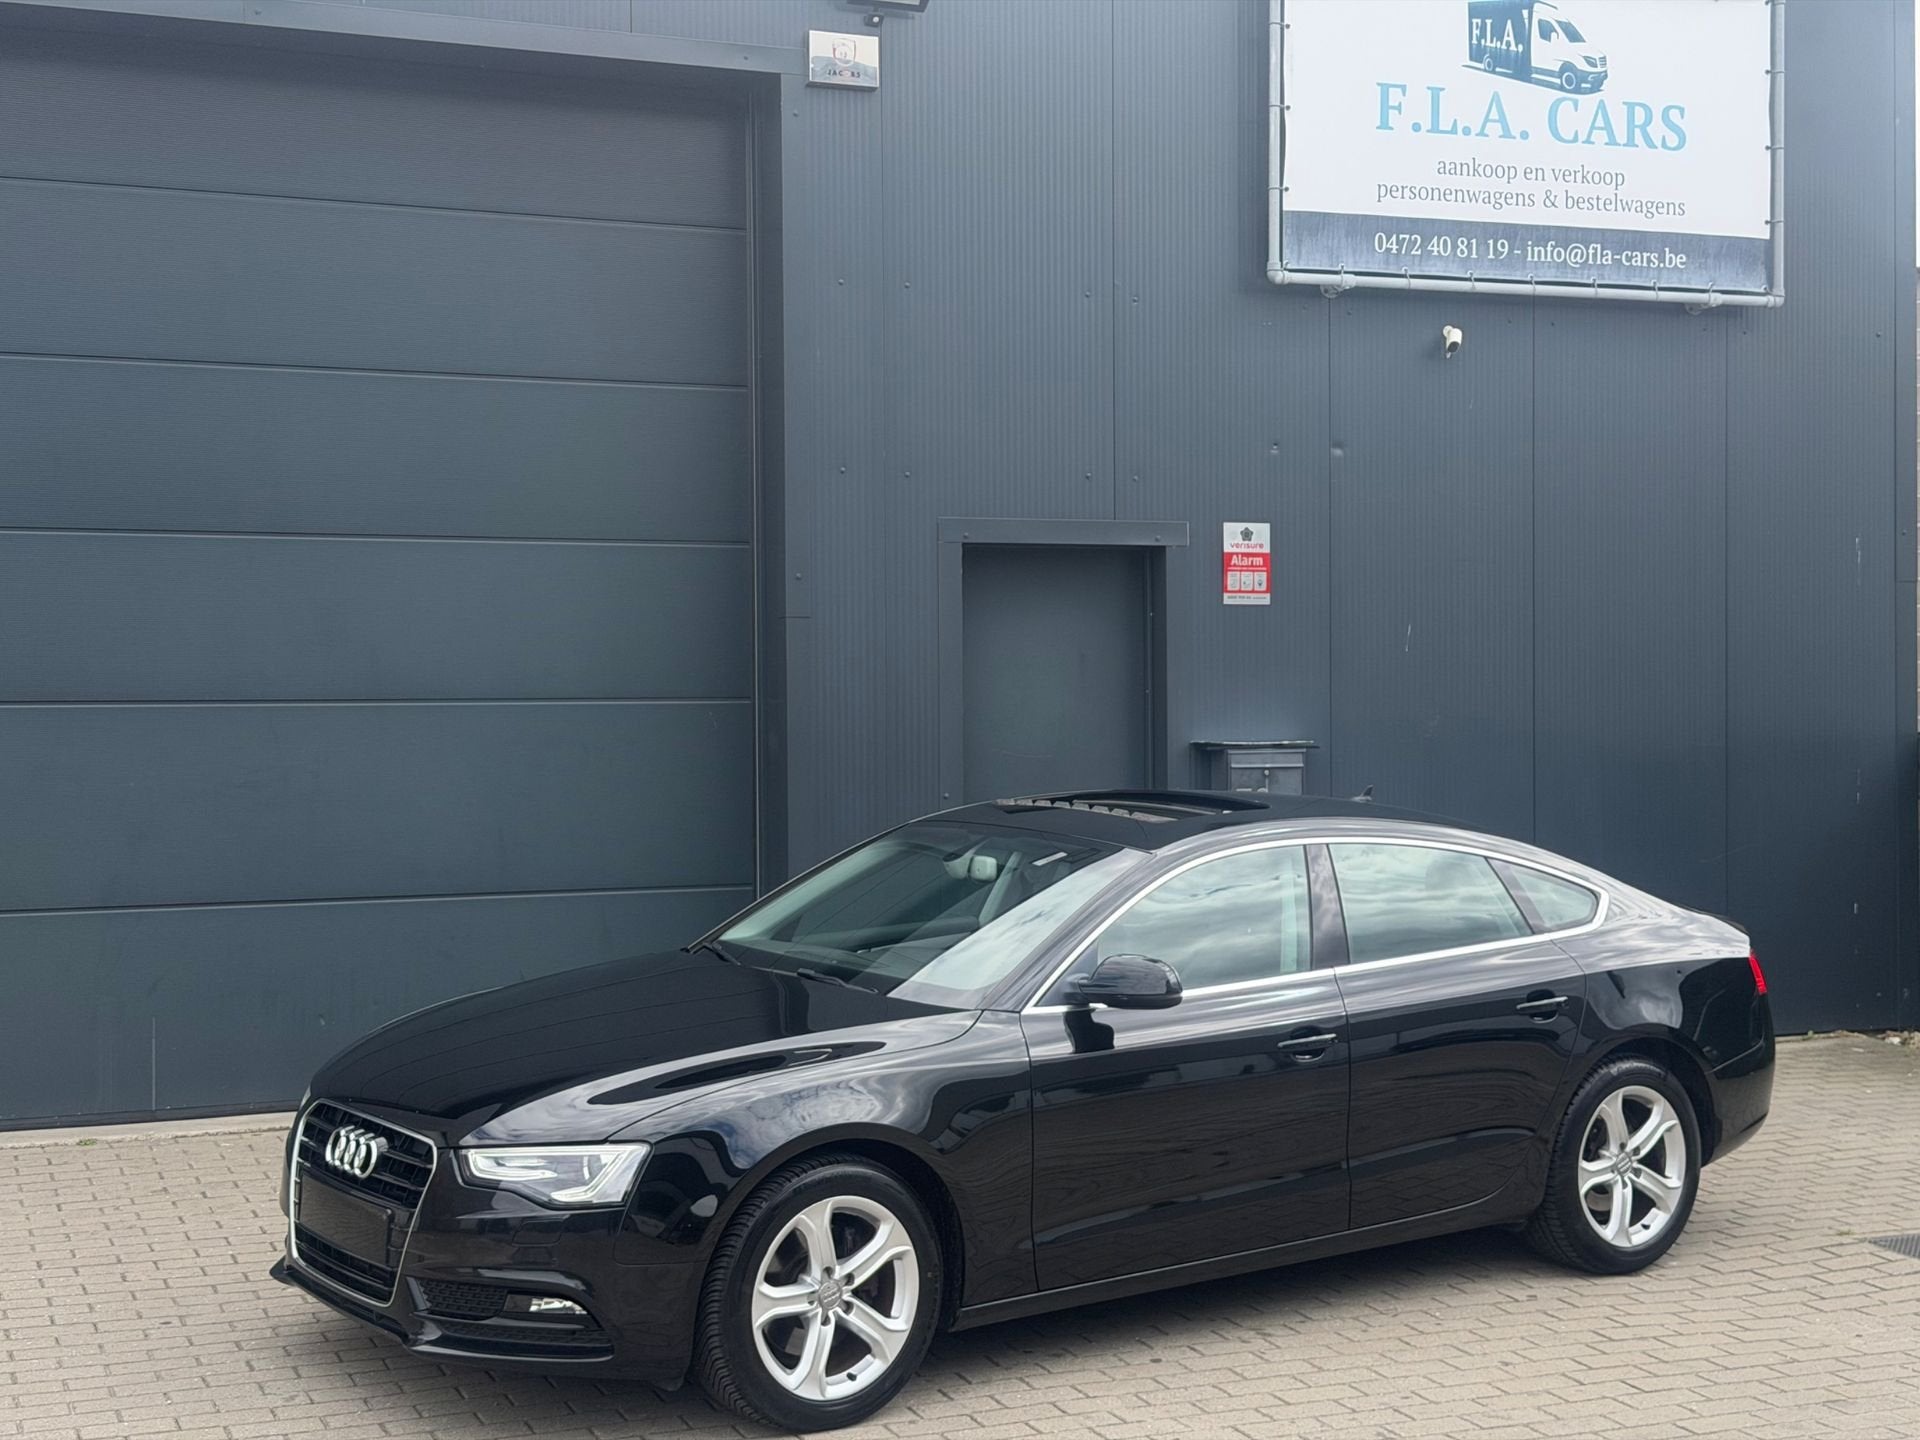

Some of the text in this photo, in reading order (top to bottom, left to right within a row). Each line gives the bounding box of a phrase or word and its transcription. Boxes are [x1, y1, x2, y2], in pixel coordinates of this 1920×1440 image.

[1471, 18, 1524, 53] F.L.A.
[1375, 81, 1688, 151] F.L.A. CARS
[1437, 157, 1625, 191] aankoop en verkoop
[1376, 182, 1686, 219] personenwagens & bestelwagens
[1374, 232, 1422, 255] 0472
[1427, 235, 1451, 257] 40
[1456, 237, 1478, 259] 81
[1487, 239, 1509, 260] 19
[1526, 241, 1687, 269] info@fla-cars.be
[1231, 554, 1264, 566] Alarm
